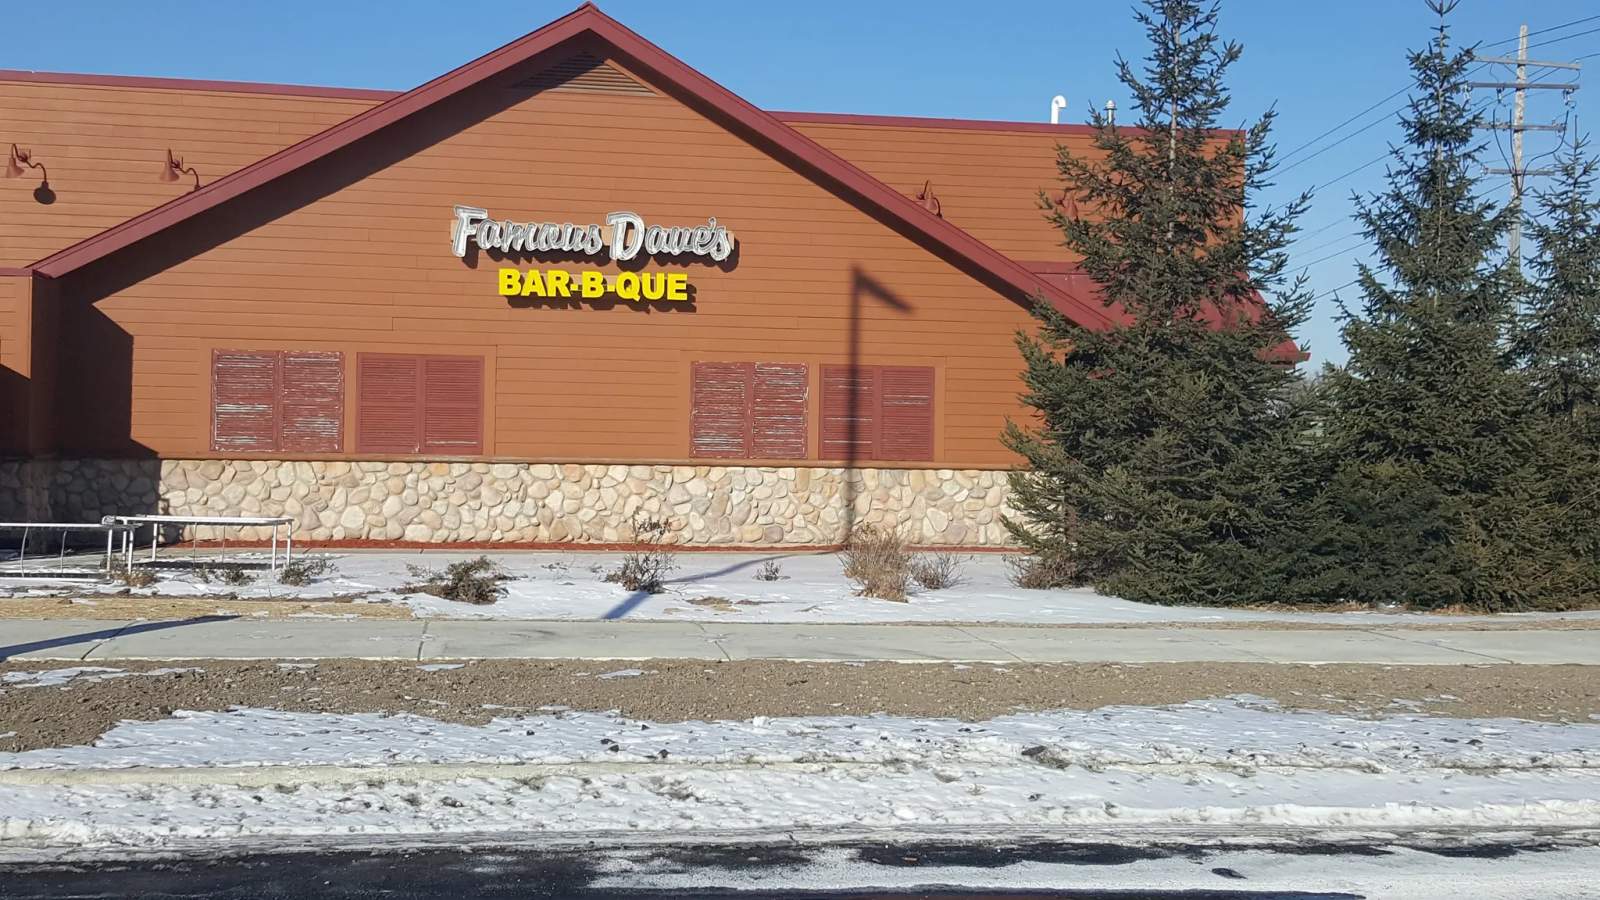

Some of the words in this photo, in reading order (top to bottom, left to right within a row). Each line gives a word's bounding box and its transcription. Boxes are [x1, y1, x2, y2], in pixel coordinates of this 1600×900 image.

[451, 205, 602, 258] Famous
[607, 211, 732, 261] Dave's
[498, 268, 688, 302] BAR-B-QUE
